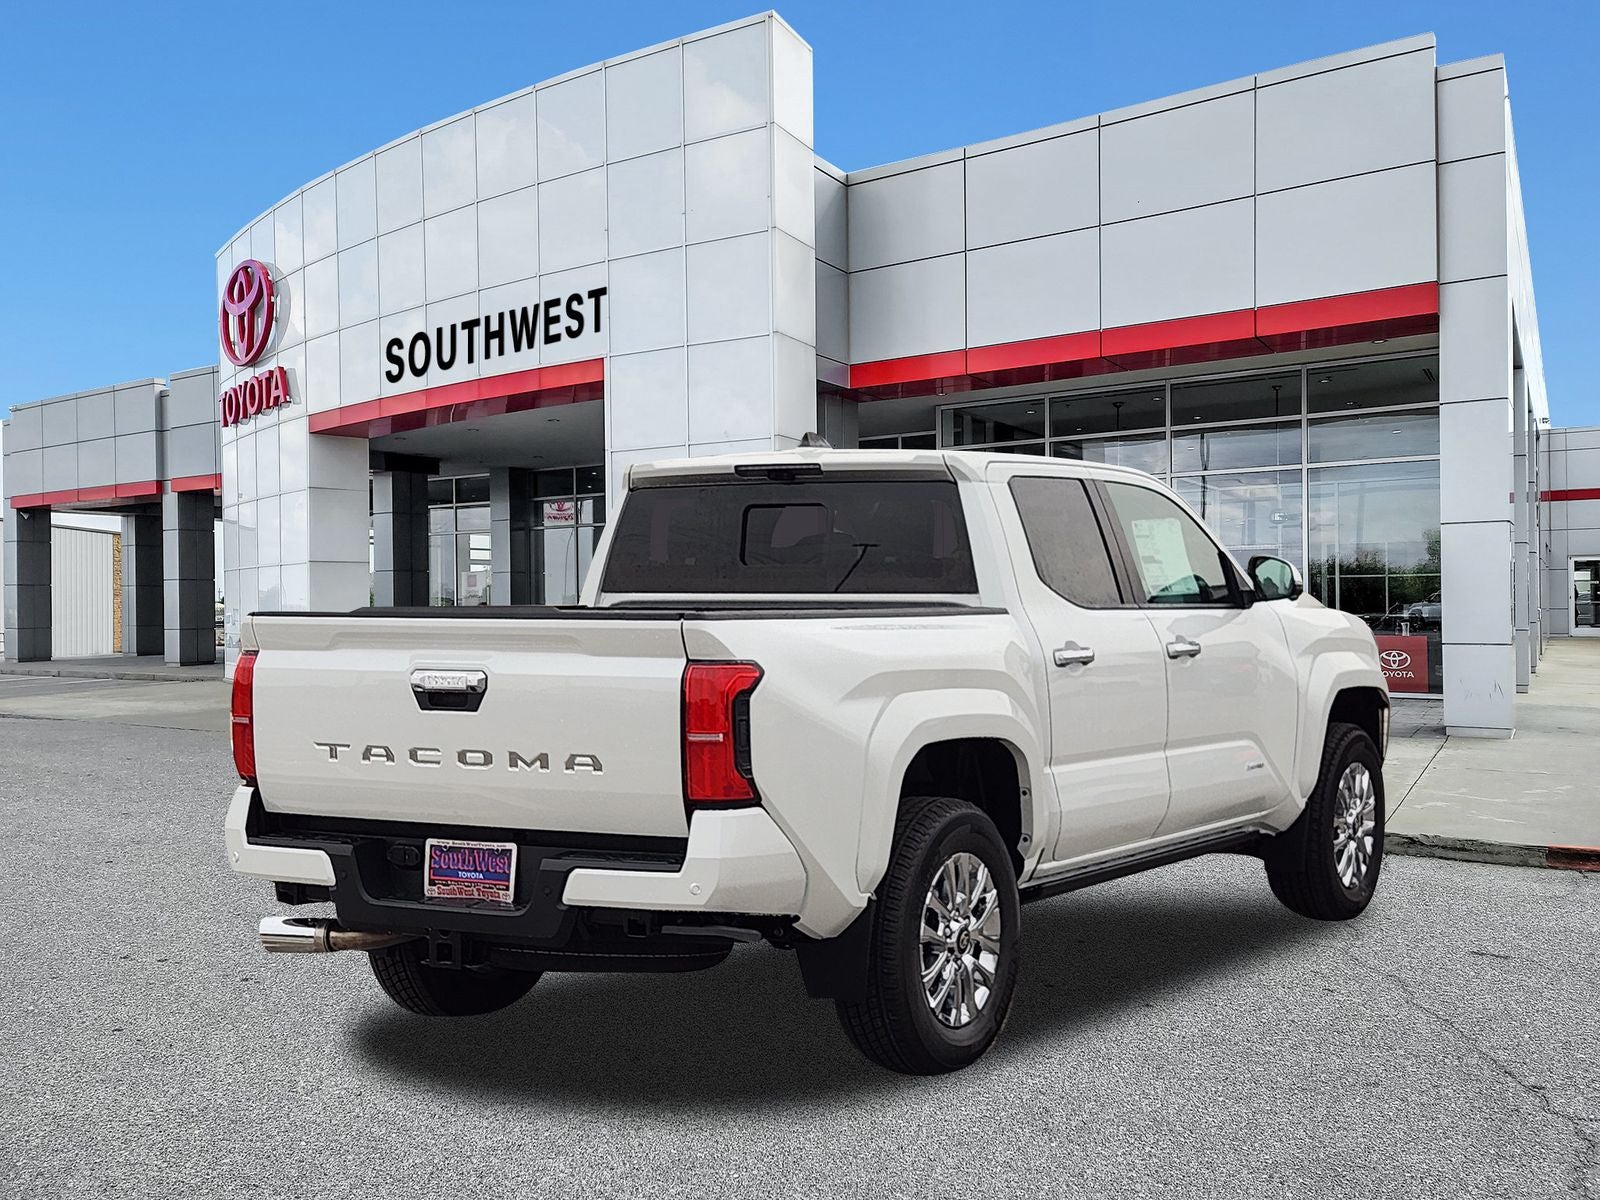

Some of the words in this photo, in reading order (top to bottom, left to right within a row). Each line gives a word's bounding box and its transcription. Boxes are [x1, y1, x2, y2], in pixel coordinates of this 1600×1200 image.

[385, 286, 608, 384] SOUTHWEST
[219, 366, 290, 428] TOYOTA
[1381, 670, 1415, 678] OYOTA
[313, 741, 604, 775] TACOMA
[458, 871, 484, 880] TOYOTA
